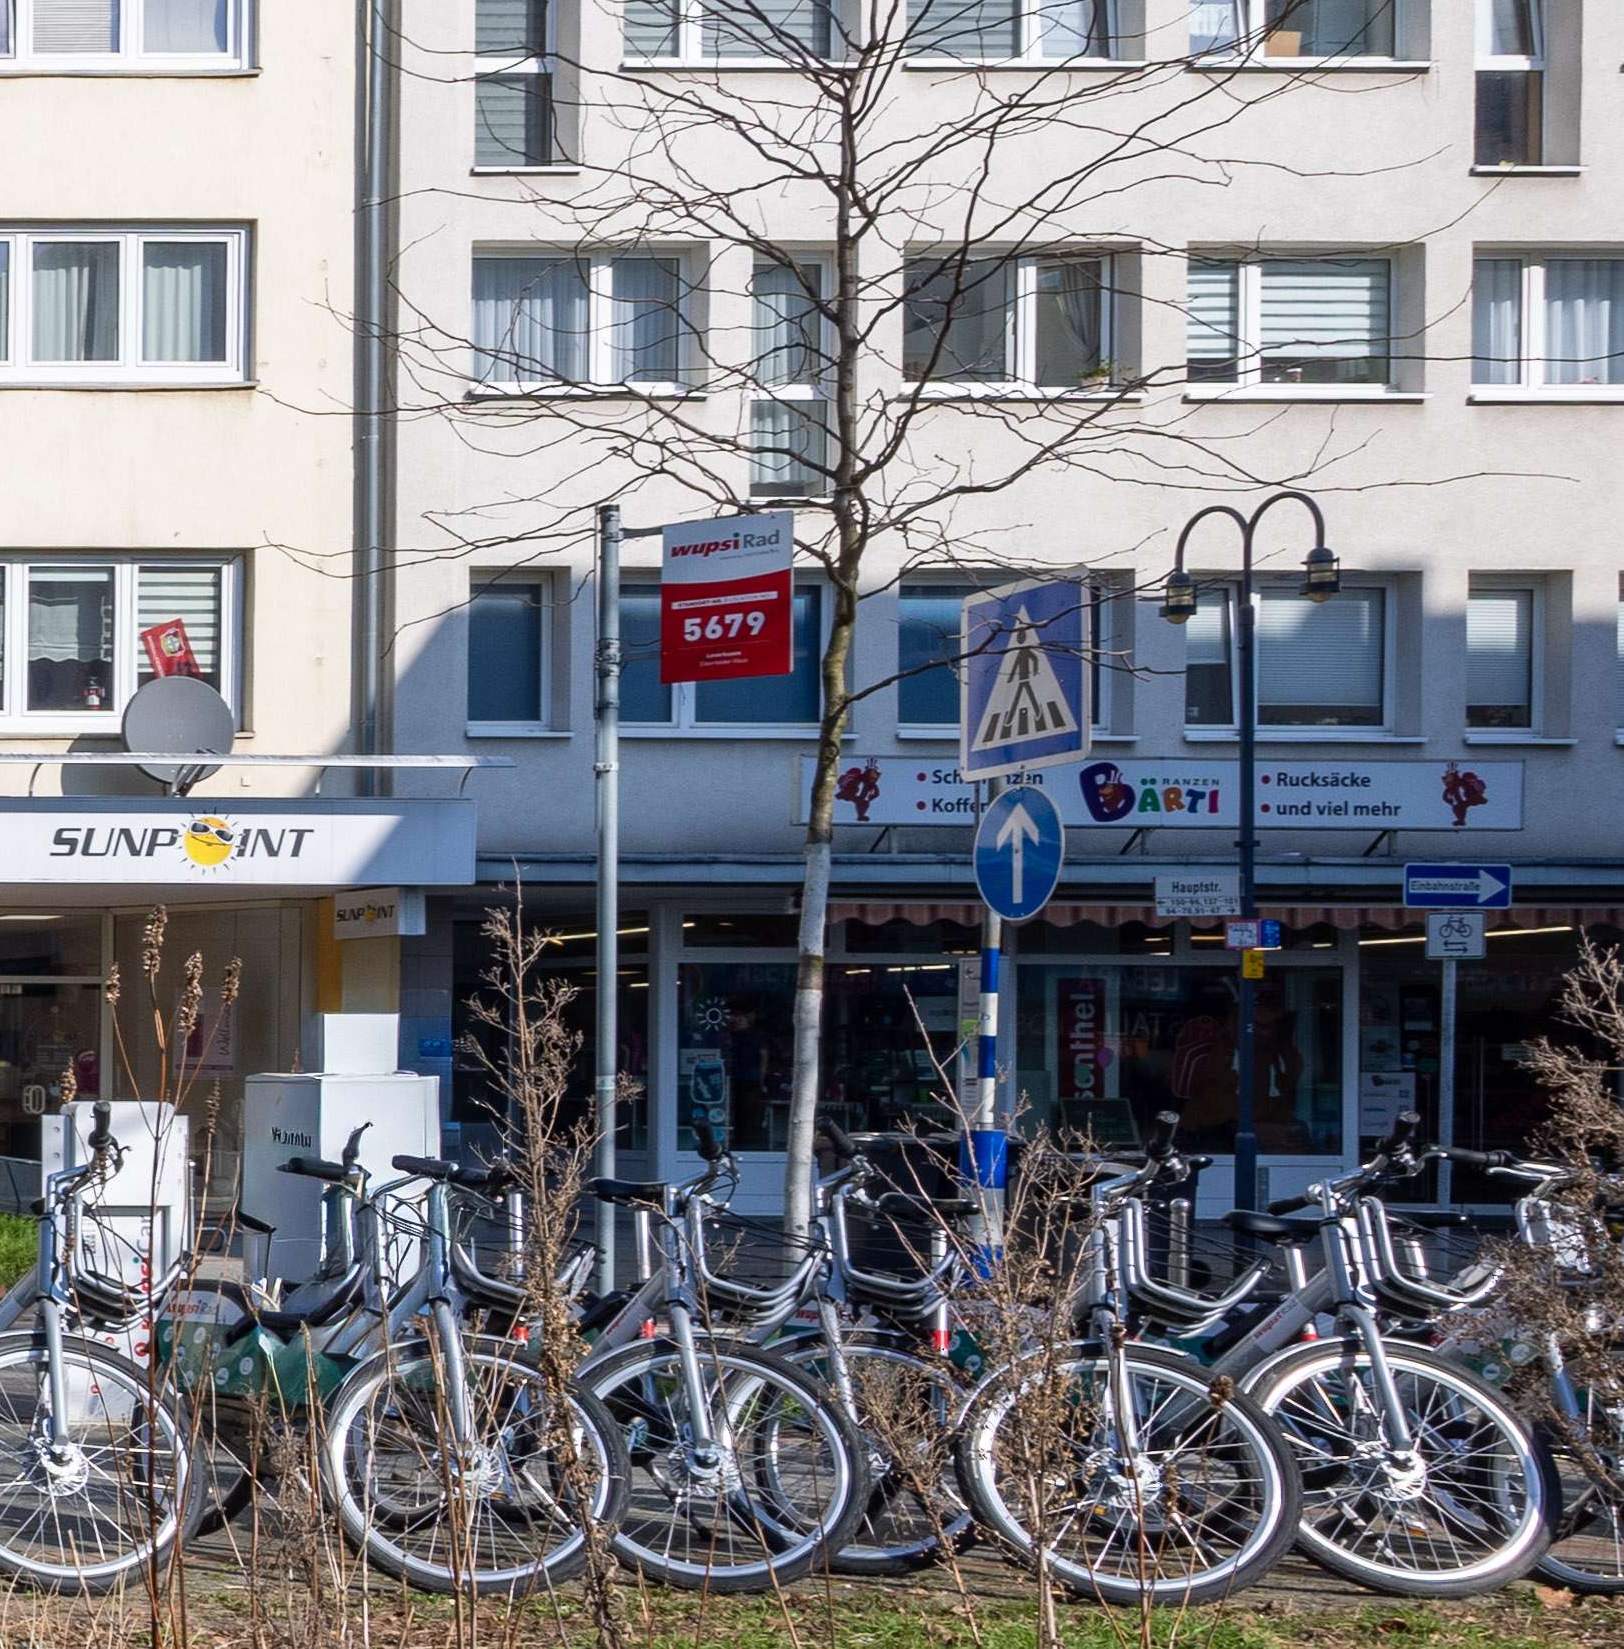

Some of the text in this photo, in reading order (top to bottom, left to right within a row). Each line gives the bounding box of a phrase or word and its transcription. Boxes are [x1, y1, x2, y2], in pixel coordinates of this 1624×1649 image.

[684, 611, 766, 642] 5679
[1162, 777, 1220, 786] RANZEN
[1276, 772, 1371, 788] Rucksäcke
[1276, 801, 1401, 817] und viel mehr
[1171, 882, 1222, 895] Hauptstr.
[1410, 880, 1481, 891] Einbahnstraße
